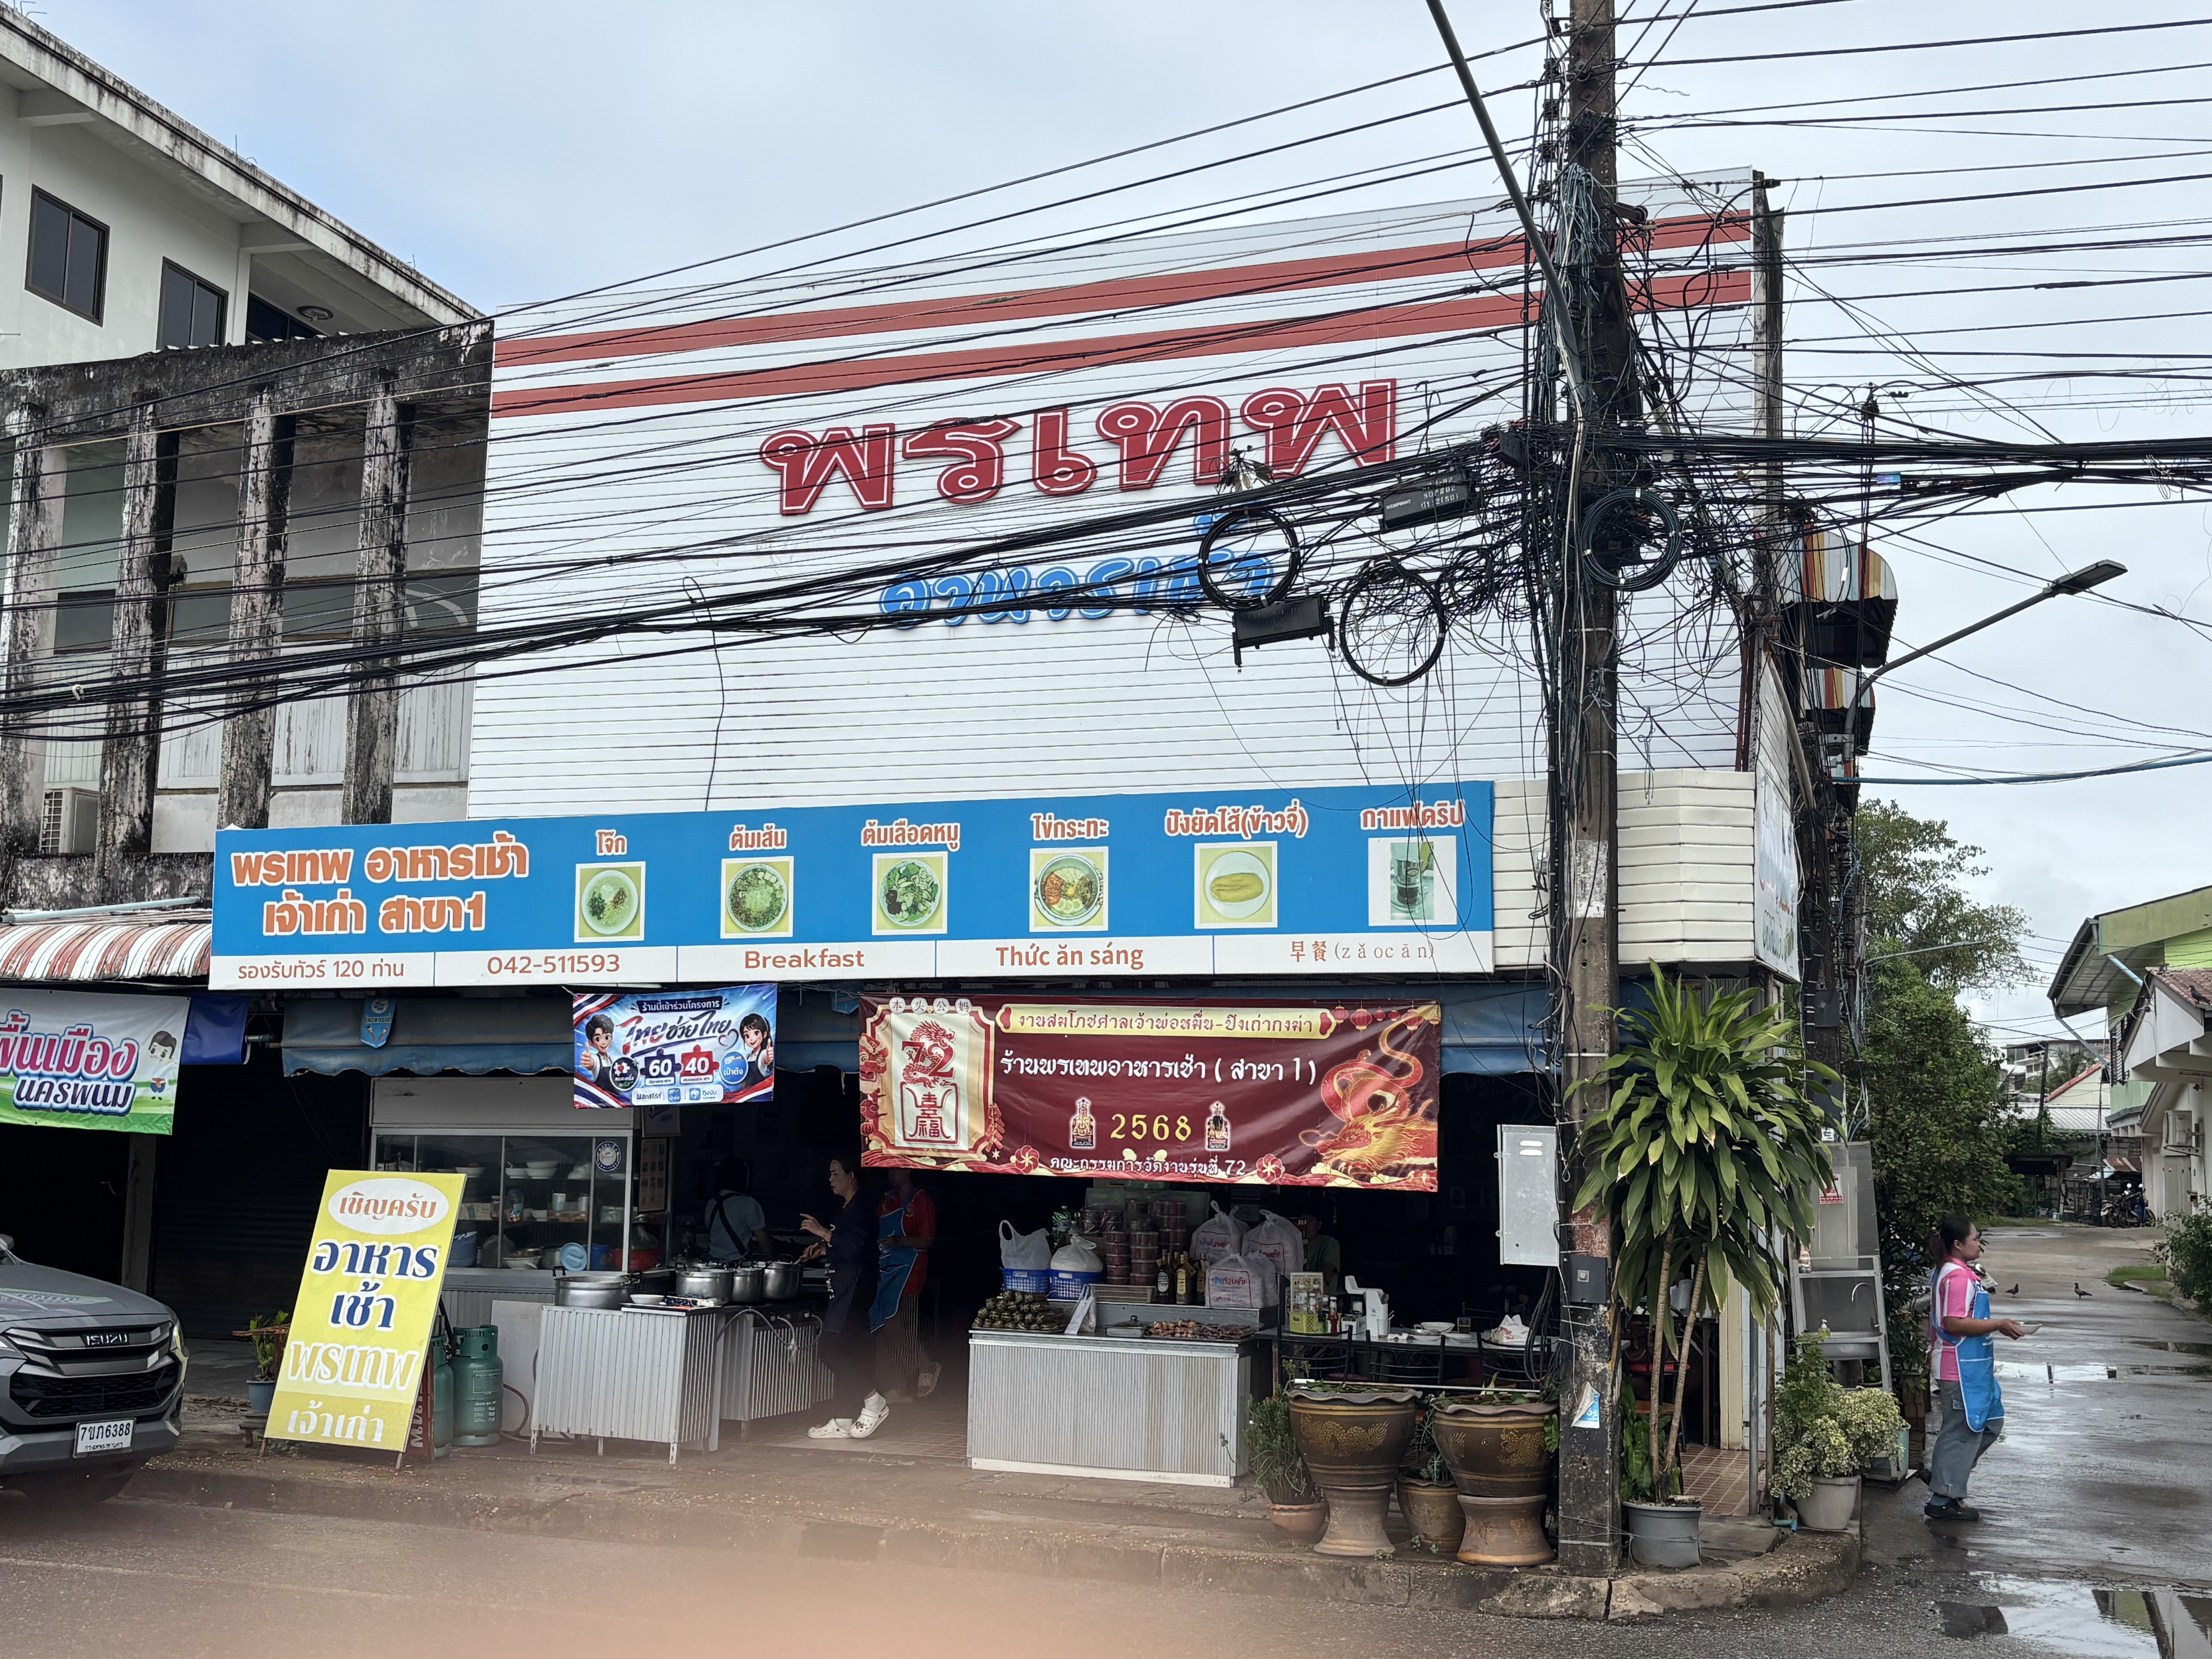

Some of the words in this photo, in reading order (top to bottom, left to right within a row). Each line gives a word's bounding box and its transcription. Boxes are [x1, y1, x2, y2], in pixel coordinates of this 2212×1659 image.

[759, 378, 1396, 515] พรเทพ
[1033, 814, 1107, 839] ไข่กระทะ
[1167, 800, 1307, 837] ปังยัดไส้(ข้าวจี่)
[1363, 801, 1464, 828] กาแฟดริป
[598, 831, 625, 854] โจ๊ก
[732, 827, 785, 849] ต้มเส้น
[863, 821, 958, 849] ต้มเลือดหมู
[234, 852, 351, 884] พรเทพ
[367, 833, 527, 881] อาหารเช้า
[265, 891, 364, 933] เจ้าเก่า
[381, 891, 483, 931] สาขา1
[488, 950, 620, 975] 042-511593
[745, 948, 864, 969] Breakfast
[996, 943, 1050, 967] Thức
[1057, 945, 1083, 966] ăn
[1090, 943, 1144, 970] sáng
[1290, 941, 1326, 962] 早餐
[239, 959, 326, 979] รองรับทัวร์
[334, 960, 364, 977] 120
[372, 958, 404, 977] ท่าน
[642, 999, 720, 1012] ร้านนี้เข้าร่วมโครงการ
[649, 1058, 672, 1077] 60
[685, 1056, 709, 1074] 40
[902, 1041, 954, 1079] 72
[1000, 1049, 1206, 1079] ร้านพรเทพอาหารเช้า
[1230, 1058, 1284, 1081] สาขา
[1293, 1057, 1300, 1081] 1
[16, 1079, 132, 1108] นครพนม
[1111, 1114, 1192, 1141] 2568
[1050, 1155, 1219, 1178] คณะกรรมการจัดงานรุ่นที่
[1225, 1159, 1246, 1176] 72
[340, 1191, 437, 1220] เชิญครับ
[313, 1242, 437, 1278] อาหาร
[331, 1281, 394, 1328] เช้า
[86, 1333, 127, 1345] ISUZU
[290, 1342, 418, 1389] พรเทพ
[287, 1400, 385, 1443] เจ้าเก่า
